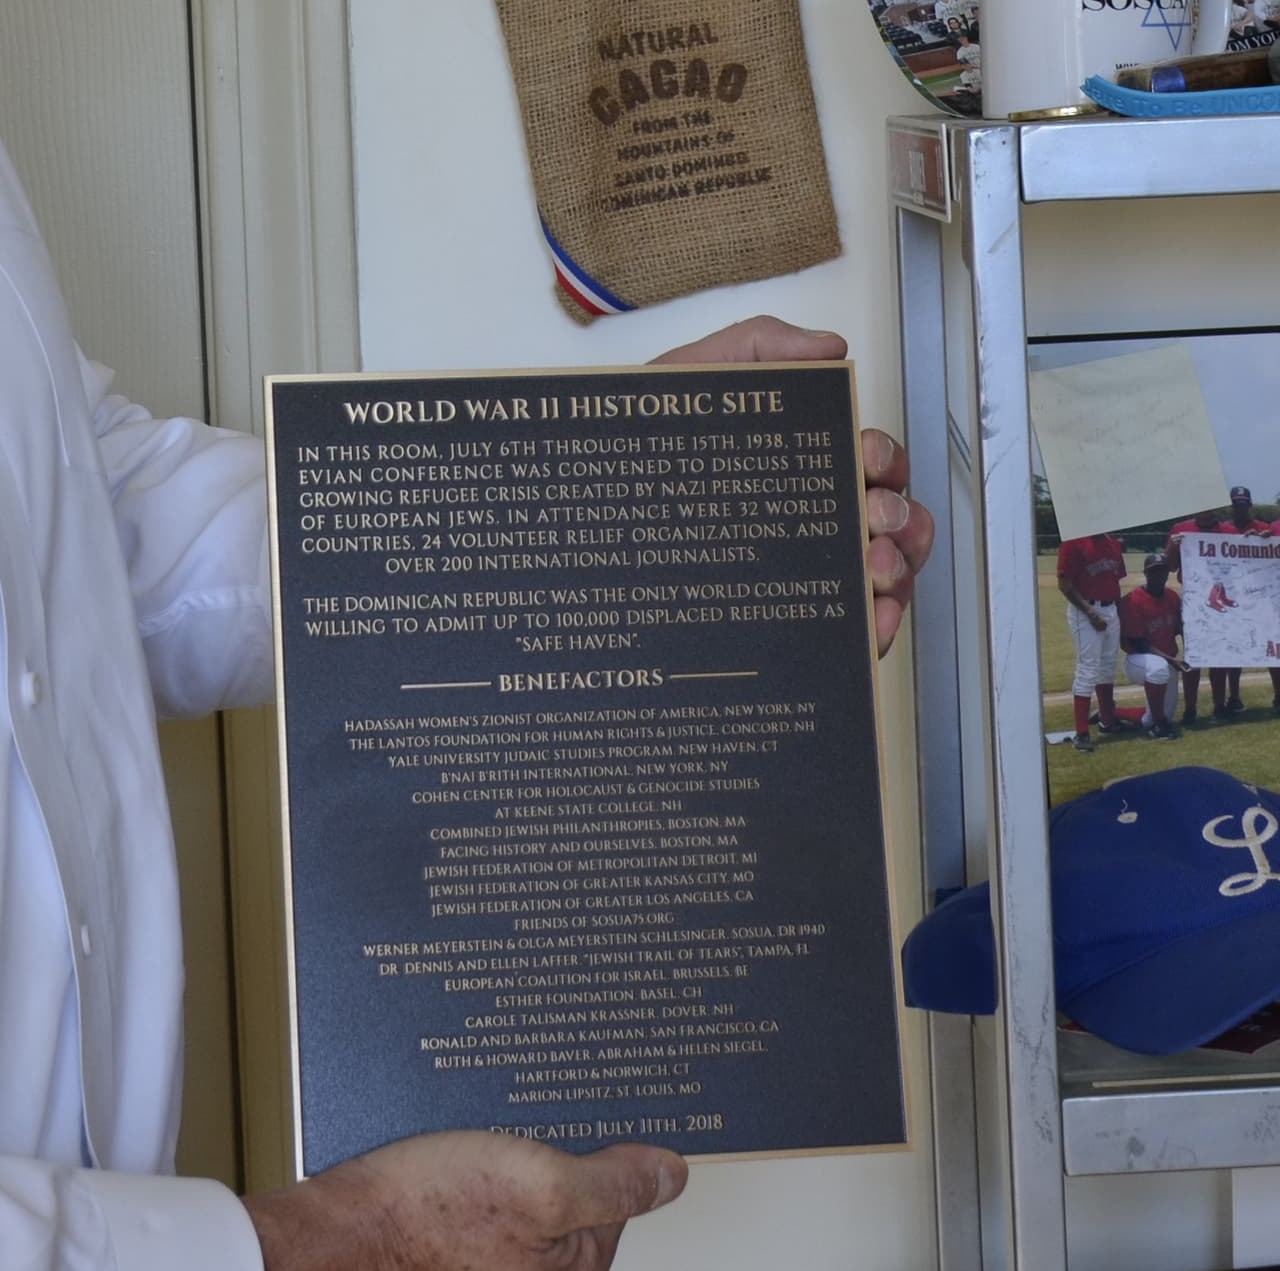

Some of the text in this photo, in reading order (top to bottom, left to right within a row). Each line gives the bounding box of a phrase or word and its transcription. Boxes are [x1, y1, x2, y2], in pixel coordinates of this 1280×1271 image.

[597, 21, 720, 62] NATURAL
[342, 389, 783, 425] WORLD WAR II HISTORIC SITE
[297, 431, 831, 464] IN THIS ROOM, JULY 6TH THROUGH THE 15TH, 1938, THE
[298, 453, 832, 485] EVIAN CONFERENCE WAS CONVENED TO DISCUSS THE
[298, 476, 834, 508] GROWING REFUGEE CRISIS CREATED BY NAZI PERSECUTION
[299, 498, 836, 531] OF EUROPEAN JEWS. IN ATTENDANCE WERE 32 WORLD
[301, 521, 838, 555] COUNTRIES, 24 VOLUNTEER RELIEF ORGANIZATIONS, AND
[1198, 540, 1217, 558] La
[384, 546, 759, 575] OVER 200 INTERNATIONAL JOURNALISTS.
[302, 579, 841, 614] THE DOMINICAN REPUBLIC WAS THE ONLY WORLD COUNTRY
[303, 602, 845, 637] WILLING TO ADMIT UP TO 100,000 DISPLACED REFUGEES AS
[515, 634, 563, 653] "SAFE
[498, 668, 663, 692] BENEFACTORS
[411, 778, 760, 804] COHEN CENTER FOR HOLOCAUST & GENOCIDE STUDIES
[595, 1118, 634, 1138] JULY
[685, 1113, 722, 1132] 2018
